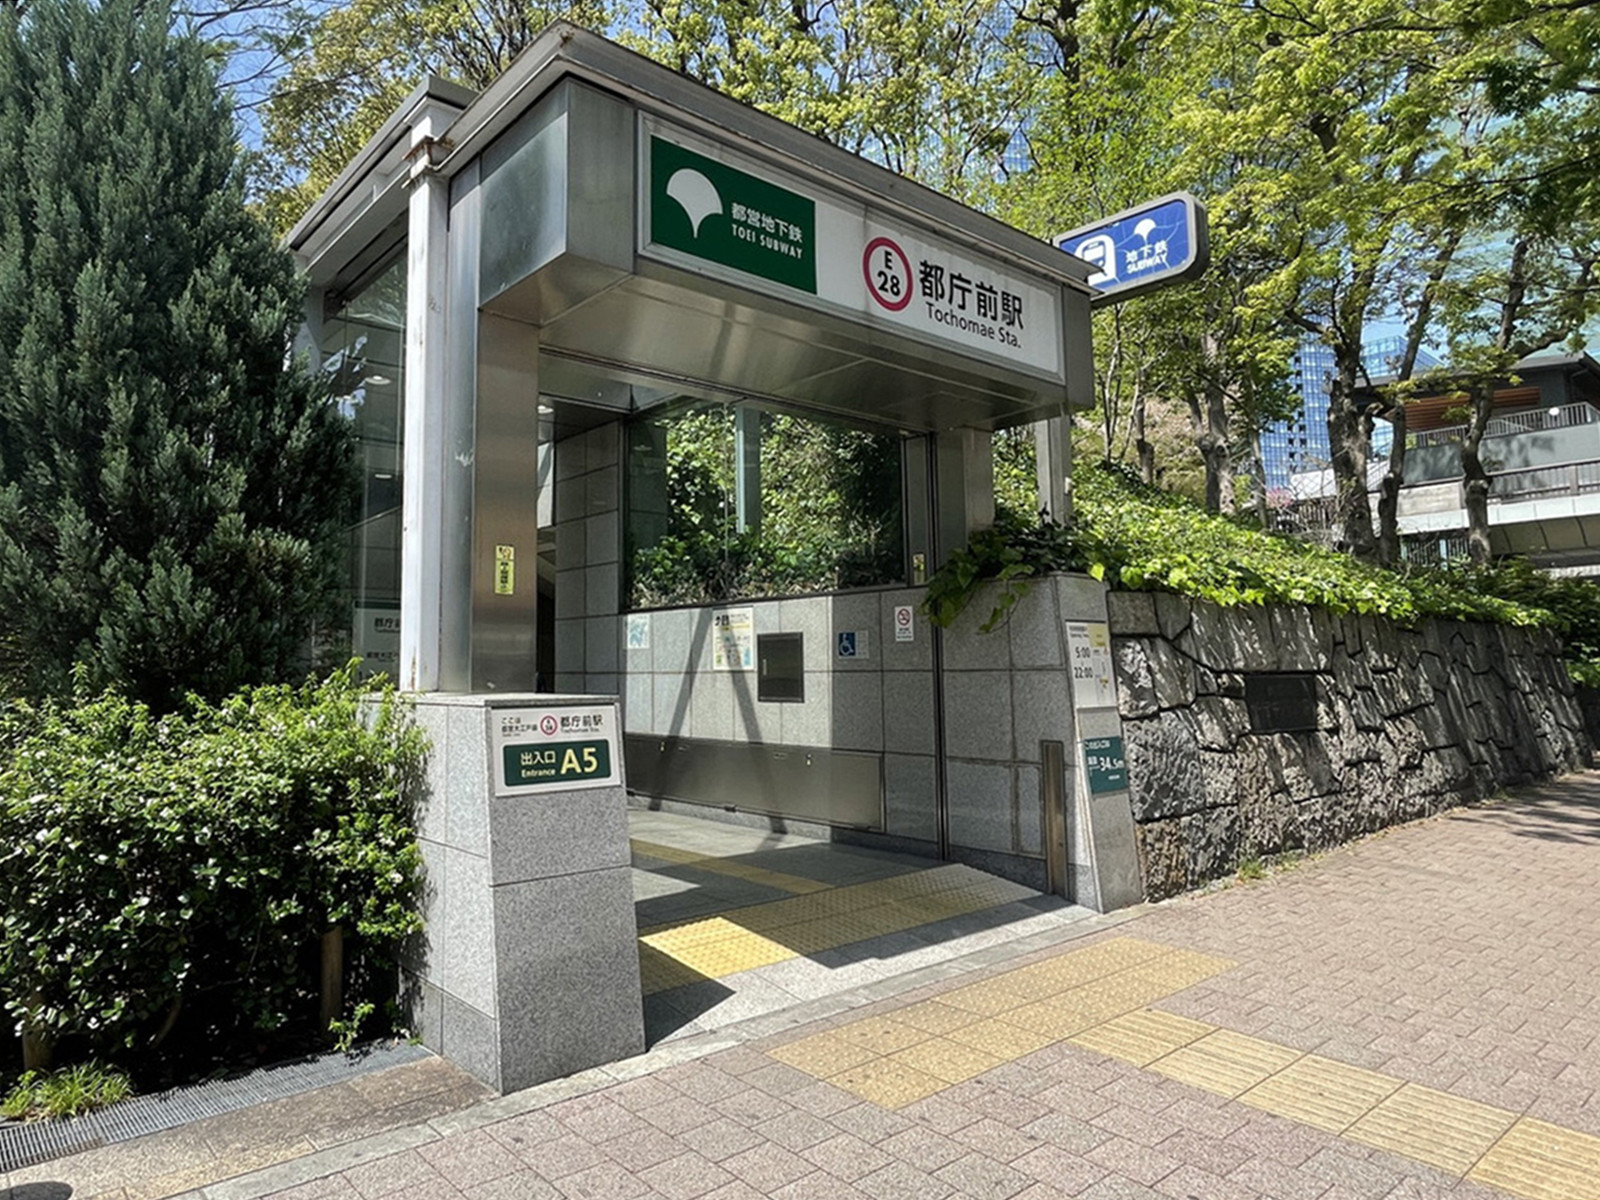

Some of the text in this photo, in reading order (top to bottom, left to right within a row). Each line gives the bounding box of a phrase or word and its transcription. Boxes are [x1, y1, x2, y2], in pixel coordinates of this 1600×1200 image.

[731, 202, 803, 243] 都営地下鉄
[732, 223, 803, 259] TOEI SUBWAY
[1125, 239, 1169, 263] 地下鉄
[884, 250, 893, 270] E
[1126, 253, 1168, 274] SUBWAY
[877, 270, 901, 297] 28
[919, 260, 1024, 330] 都庁前駅
[926, 301, 1022, 349] Tochomae Sta.
[560, 714, 604, 728] 都庁前駅
[520, 750, 556, 766] 出入口
[560, 746, 598, 775] A5
[521, 768, 556, 778] Entrance
